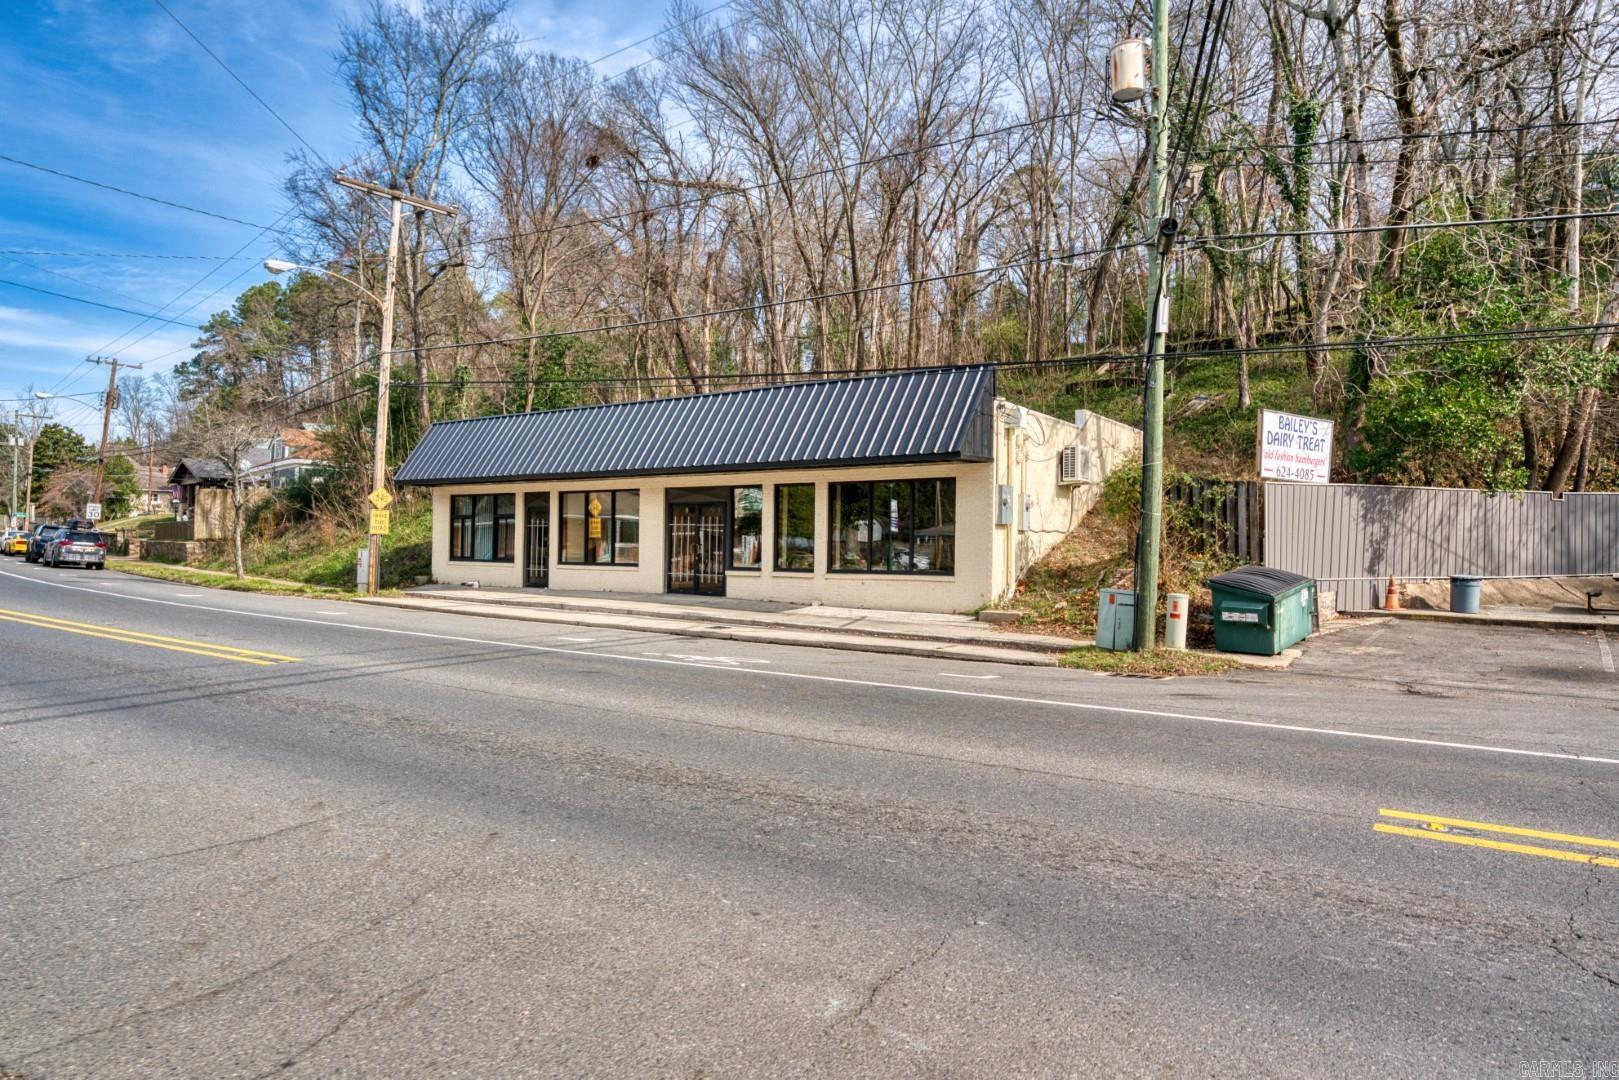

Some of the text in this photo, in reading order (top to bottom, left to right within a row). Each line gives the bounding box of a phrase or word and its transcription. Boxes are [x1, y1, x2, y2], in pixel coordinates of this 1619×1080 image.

[1278, 415, 1318, 435] BAILEY'S
[1266, 430, 1326, 452] DAIRY TREAT
[1276, 466, 1314, 480] 624-4085
